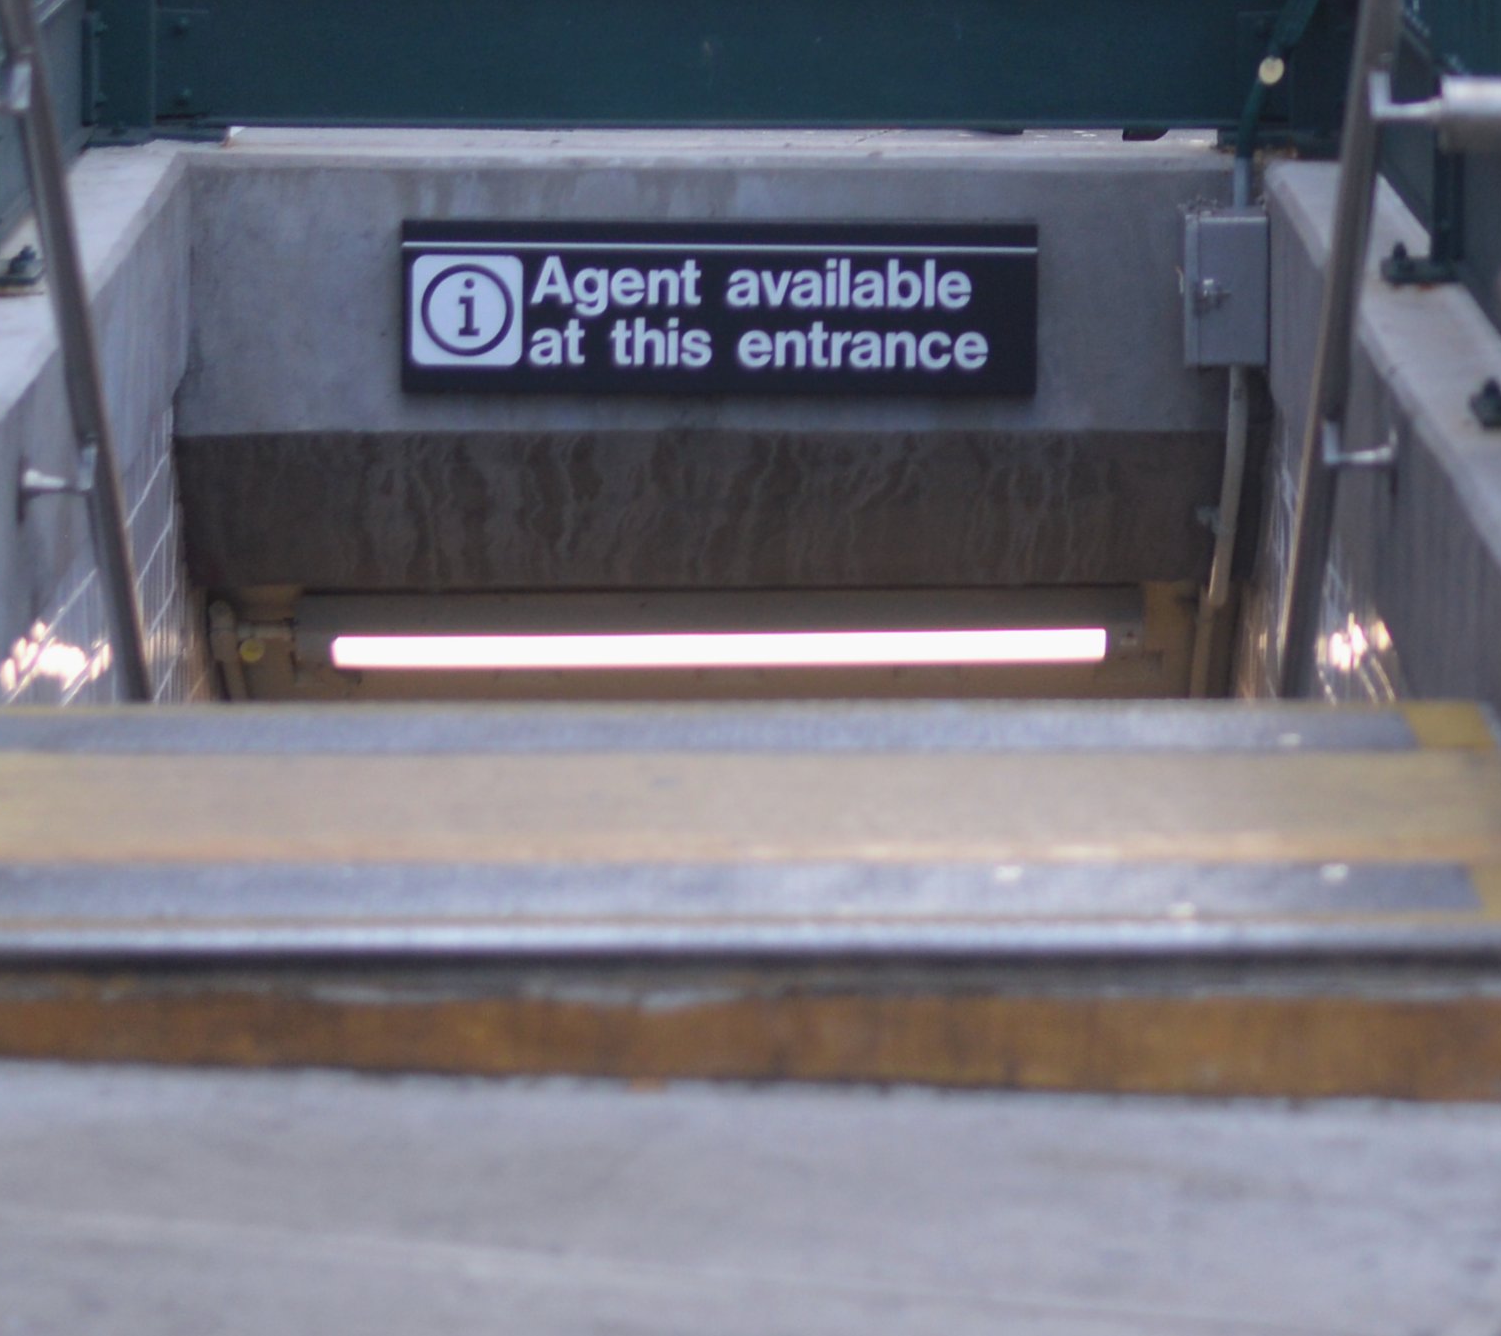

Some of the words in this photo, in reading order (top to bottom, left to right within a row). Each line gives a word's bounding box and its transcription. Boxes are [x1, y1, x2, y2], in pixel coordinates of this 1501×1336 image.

[529, 255, 702, 316] Agent
[725, 258, 973, 308] available
[529, 319, 586, 366] at
[611, 318, 713, 366] this
[737, 321, 989, 369] entrance
